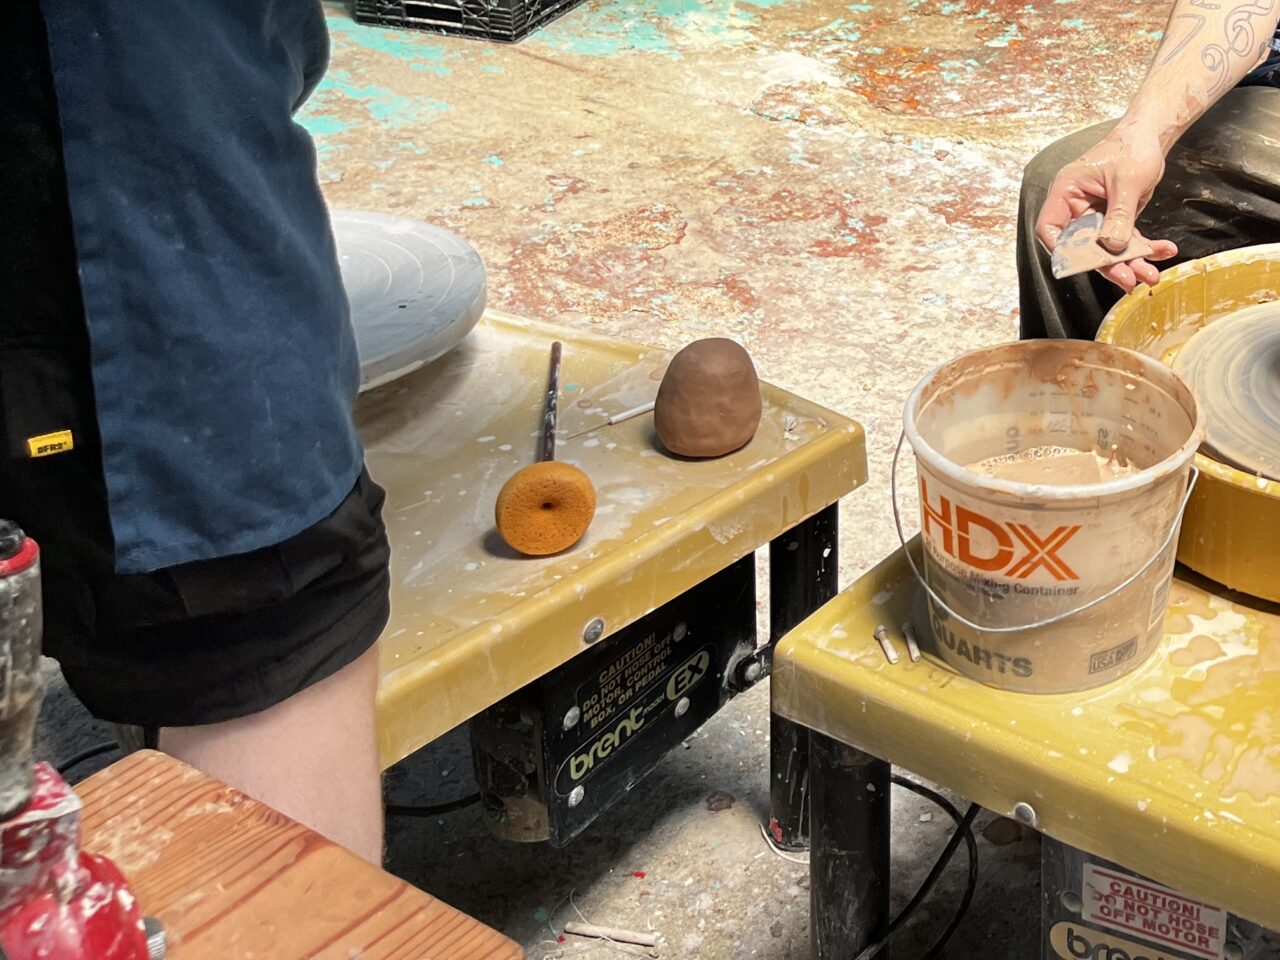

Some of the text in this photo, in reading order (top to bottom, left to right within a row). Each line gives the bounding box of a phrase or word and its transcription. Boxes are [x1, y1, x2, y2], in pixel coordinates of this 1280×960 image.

[921, 475, 1083, 581] HDX
[1014, 583, 1079, 596] Container
[583, 632, 673, 712] DO NOT HOSE OFF
[600, 632, 656, 684] CAUTION!
[583, 648, 673, 723] MOTOR, CONTROL
[591, 663, 668, 728] BOX, OR PEDAL
[569, 704, 645, 780] brent
[674, 651, 705, 692] EX
[1110, 881, 1201, 918] CAUTION!
[1124, 900, 1163, 920] NOT
[1168, 912, 1220, 938] HOSE
[1067, 927, 1164, 960] bre
[1100, 905, 1211, 949] OFF MOTOR
